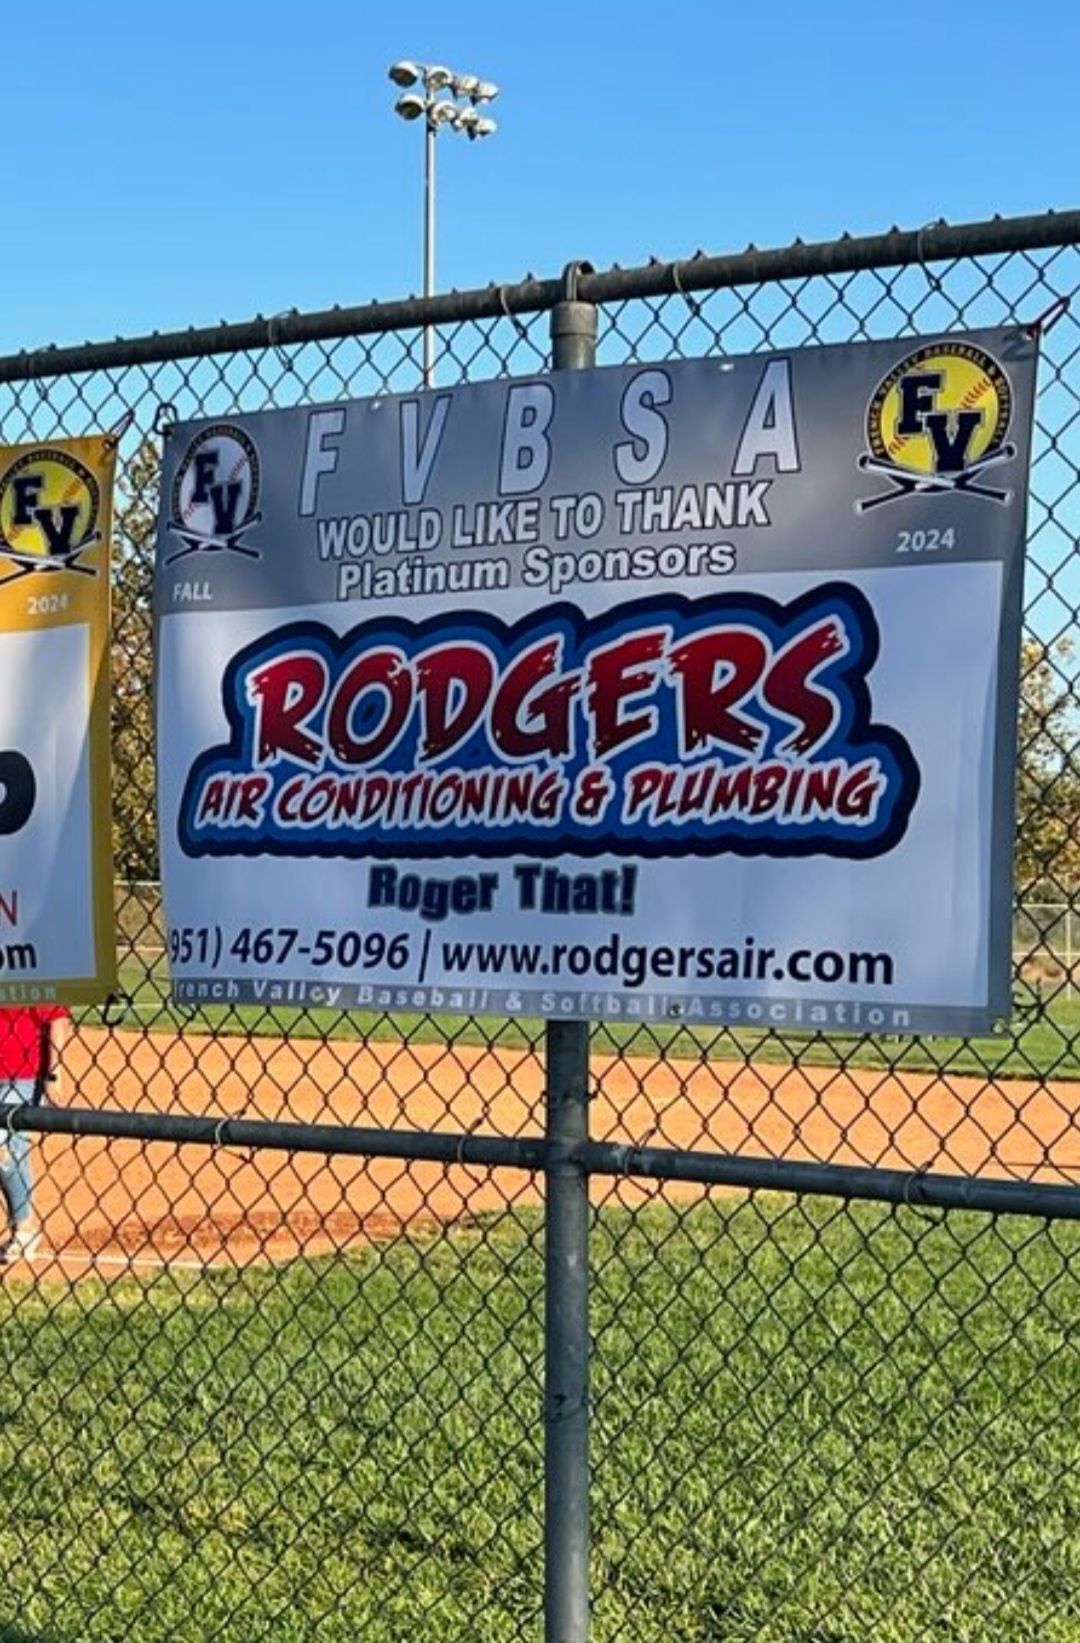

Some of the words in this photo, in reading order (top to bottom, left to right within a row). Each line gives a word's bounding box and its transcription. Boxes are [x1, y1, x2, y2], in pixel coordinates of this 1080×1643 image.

[317, 507, 443, 561] WOULD
[451, 499, 541, 549] LIKE
[550, 492, 604, 541] TO
[615, 480, 774, 535] THANK
[896, 527, 955, 553] 2024
[172, 581, 213, 602] FALL
[337, 557, 511, 601] Platinum
[521, 541, 737, 595] Sponsors
[27, 593, 69, 616] 2024
[247, 615, 846, 768] RODGERS
[196, 772, 272, 829] AIR
[274, 763, 568, 828] CONDITIONING
[574, 765, 614, 824] &
[622, 757, 887, 826] PLUMBING
[367, 863, 500, 922] Roger
[513, 863, 638, 917] That!
[229, 927, 410, 971] 467-5096
[442, 932, 894, 989] www.rodgersair.com
[357, 985, 488, 1009] Baseball
[505, 996, 522, 1012] &
[541, 992, 668, 1016] Softball
[687, 998, 911, 1027] Association
